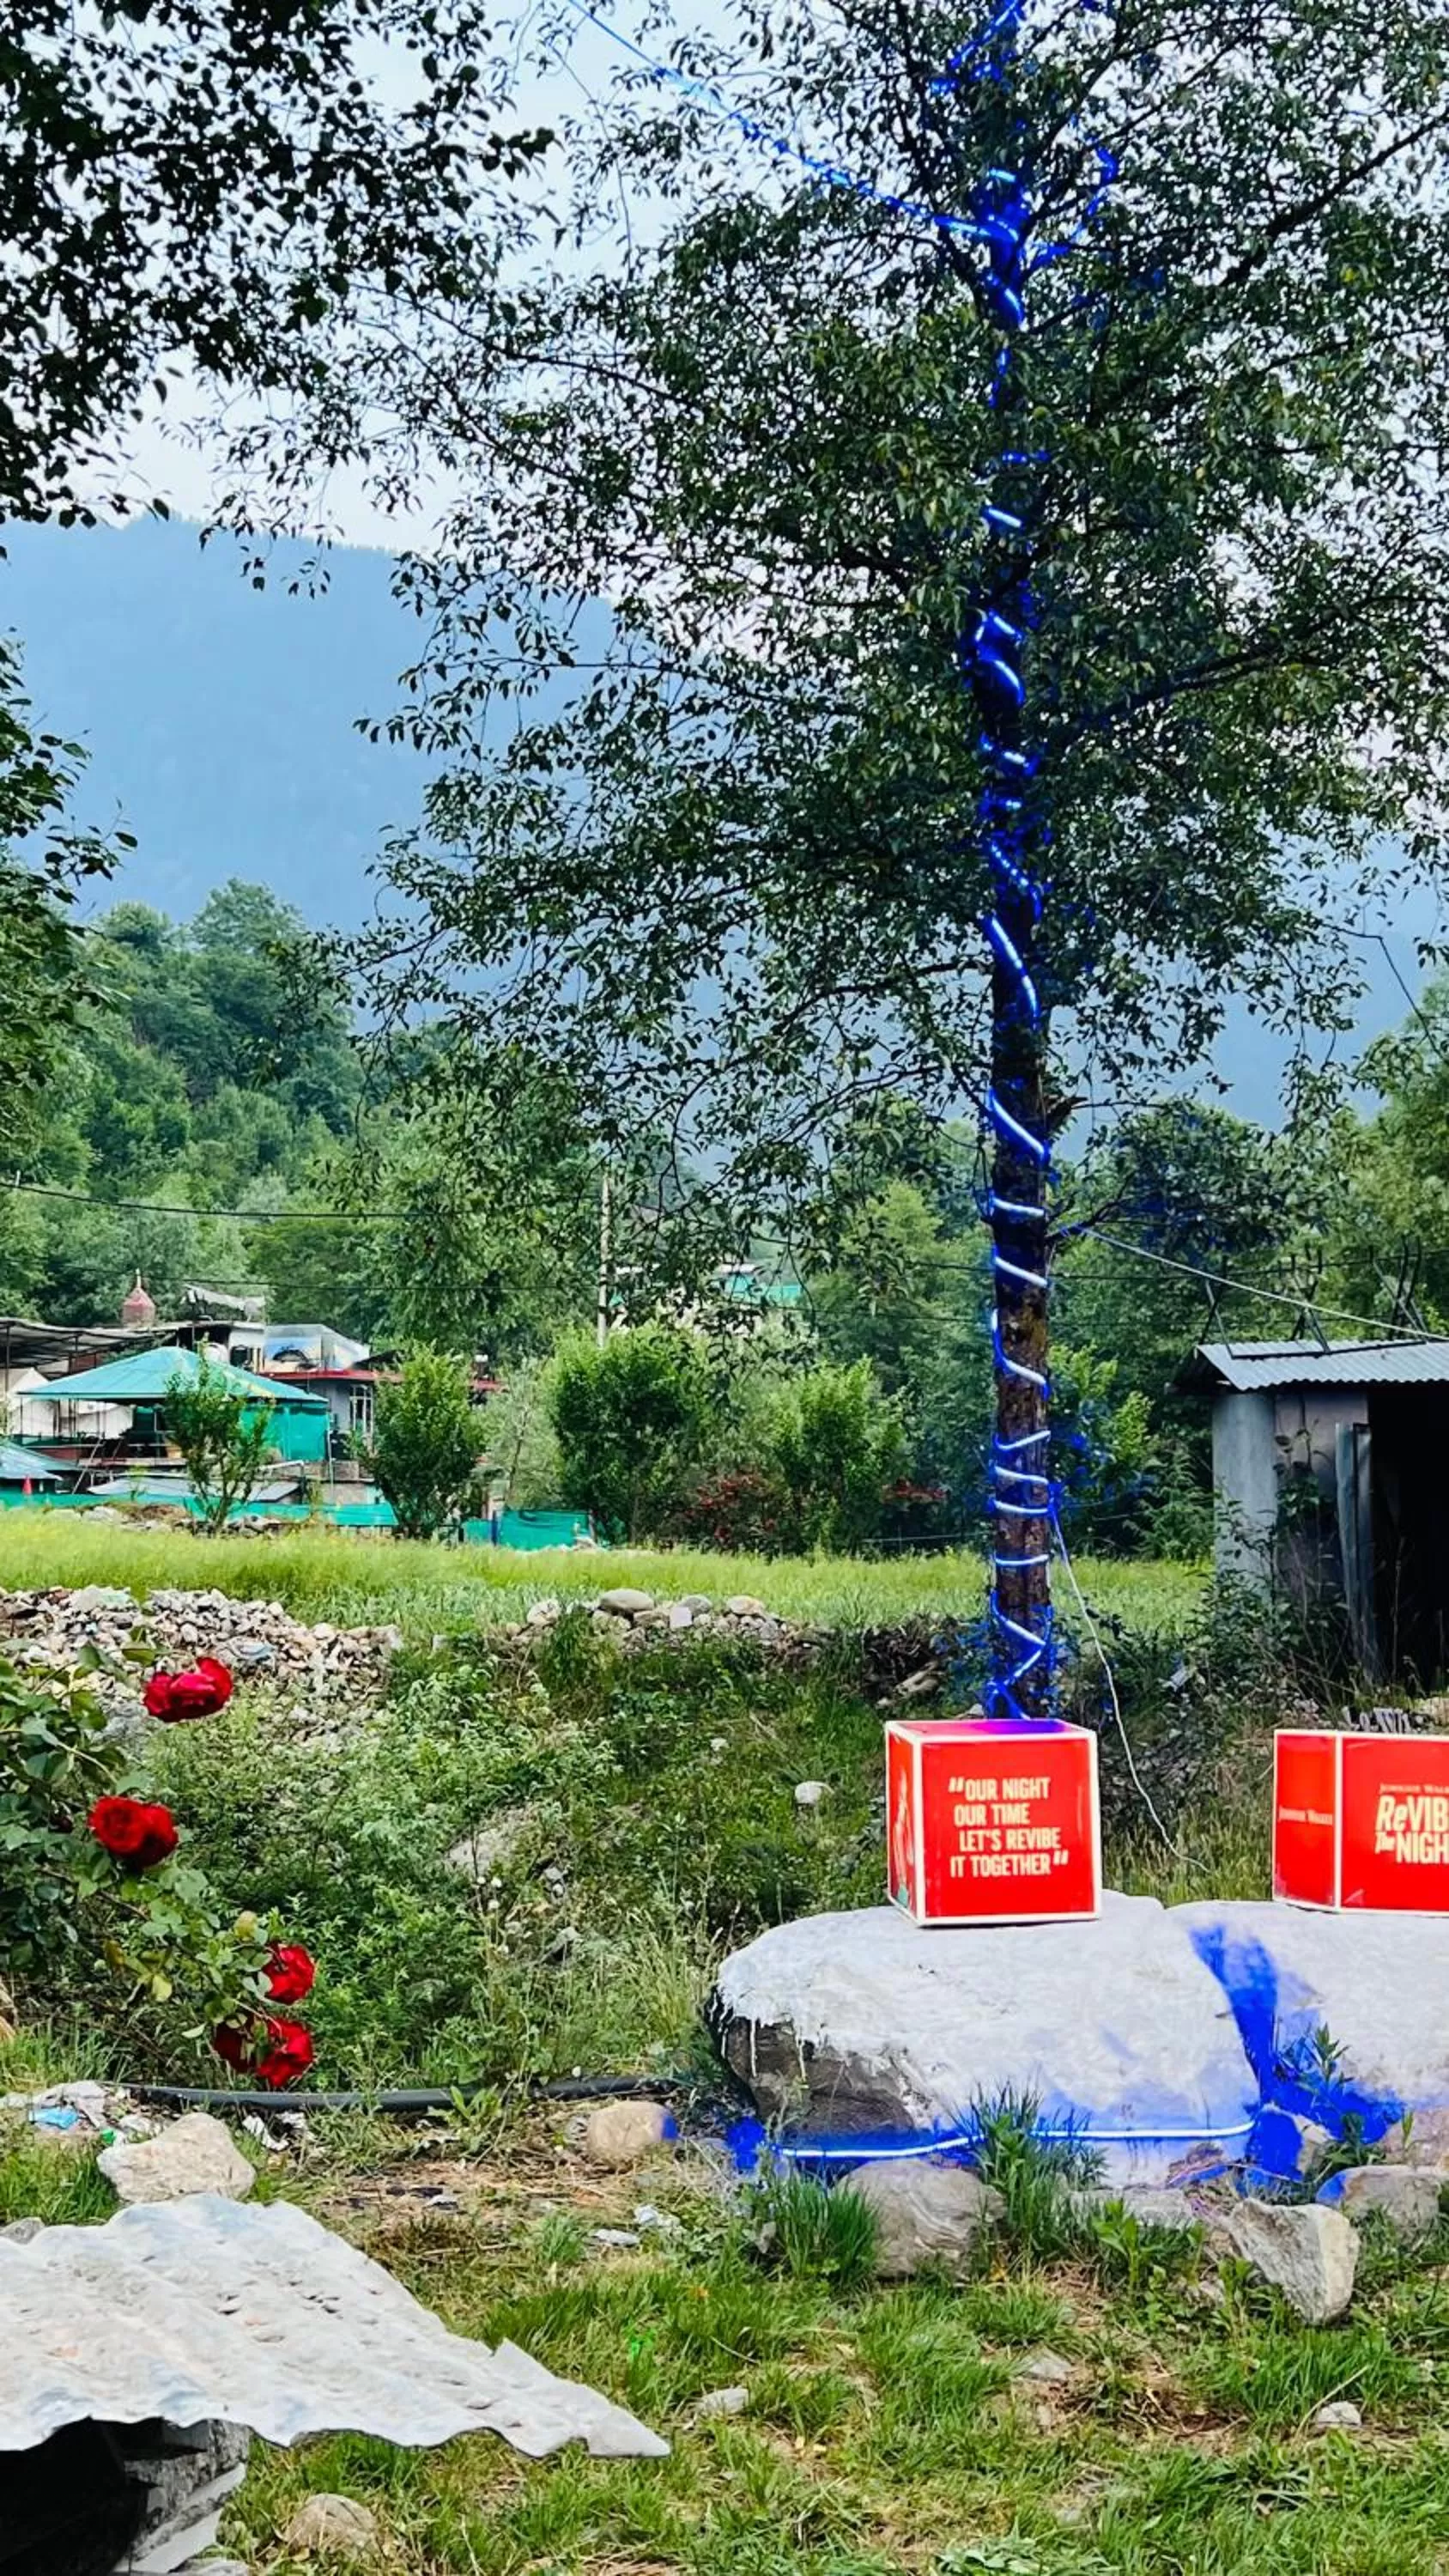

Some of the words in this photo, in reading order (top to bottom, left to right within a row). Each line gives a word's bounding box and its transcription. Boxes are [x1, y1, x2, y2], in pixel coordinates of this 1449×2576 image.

[1003, 1777, 1051, 1800] NIGHT
[954, 1804, 986, 1826] OUR
[991, 1803, 1031, 1826] TIME
[959, 1829, 1001, 1852] LET'S
[1006, 1827, 1061, 1850] REVIBE
[950, 1856, 966, 1878] IT
